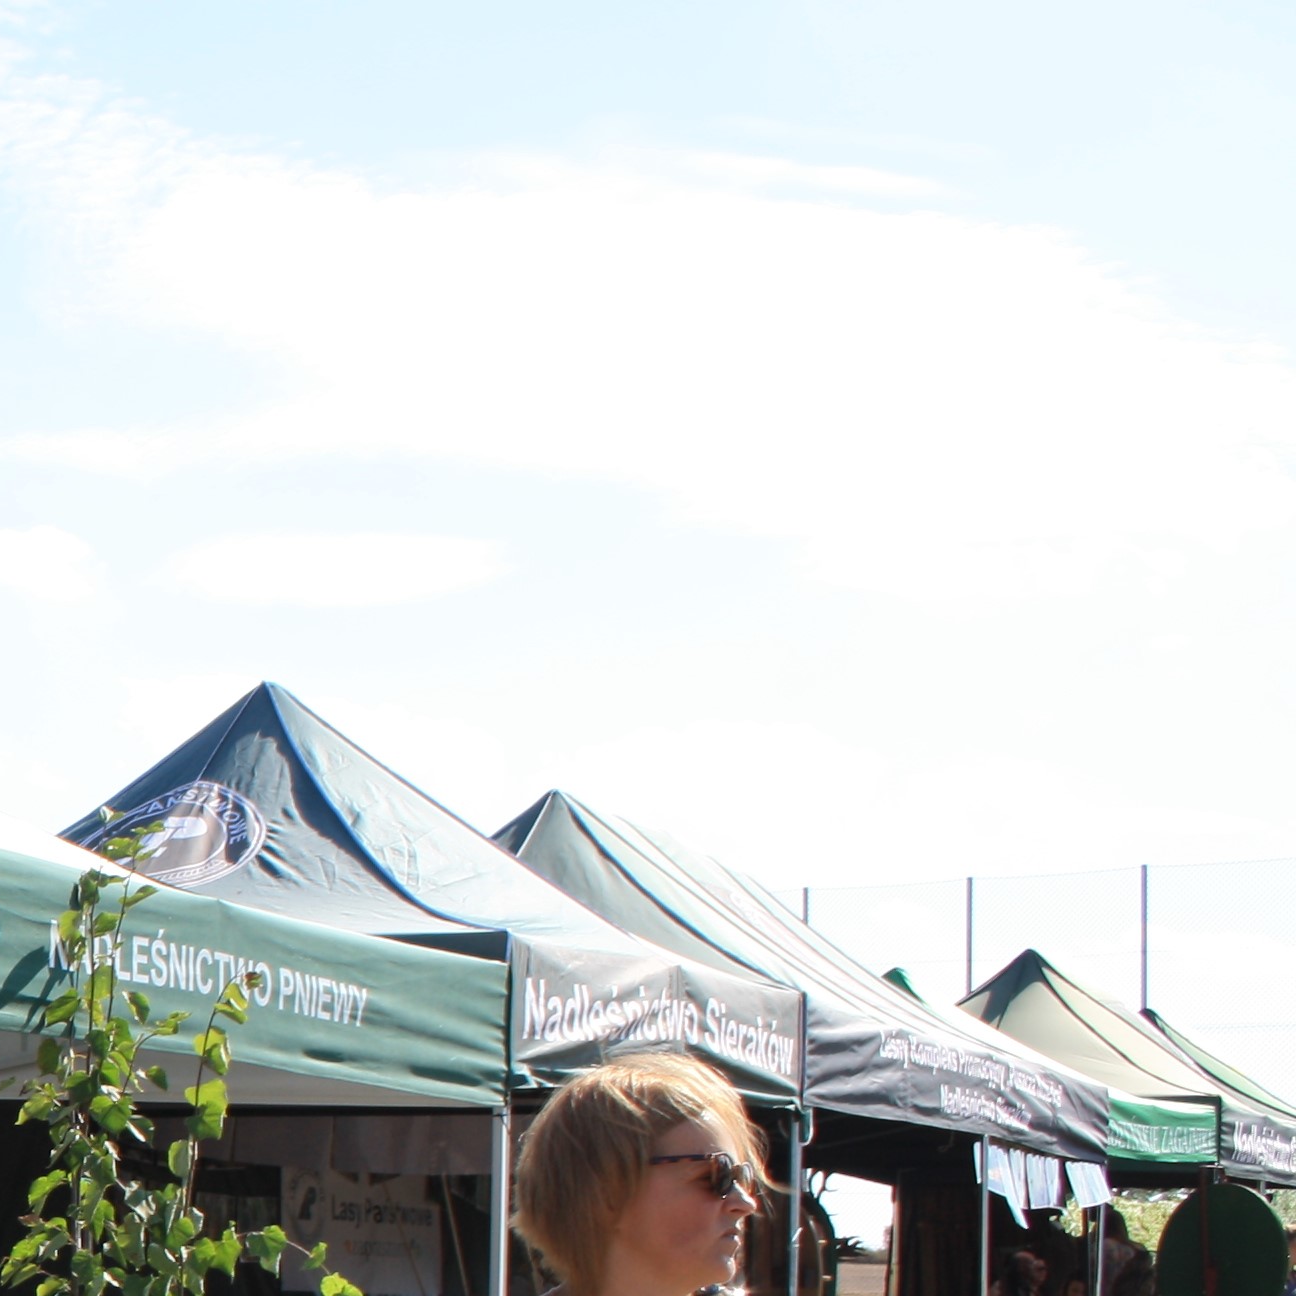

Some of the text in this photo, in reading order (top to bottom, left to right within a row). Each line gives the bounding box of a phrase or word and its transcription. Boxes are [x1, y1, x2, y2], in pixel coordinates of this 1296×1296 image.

[278, 967, 367, 1027] PNIEWY
[522, 977, 795, 1075] Nadleśnictwo Sieraków
